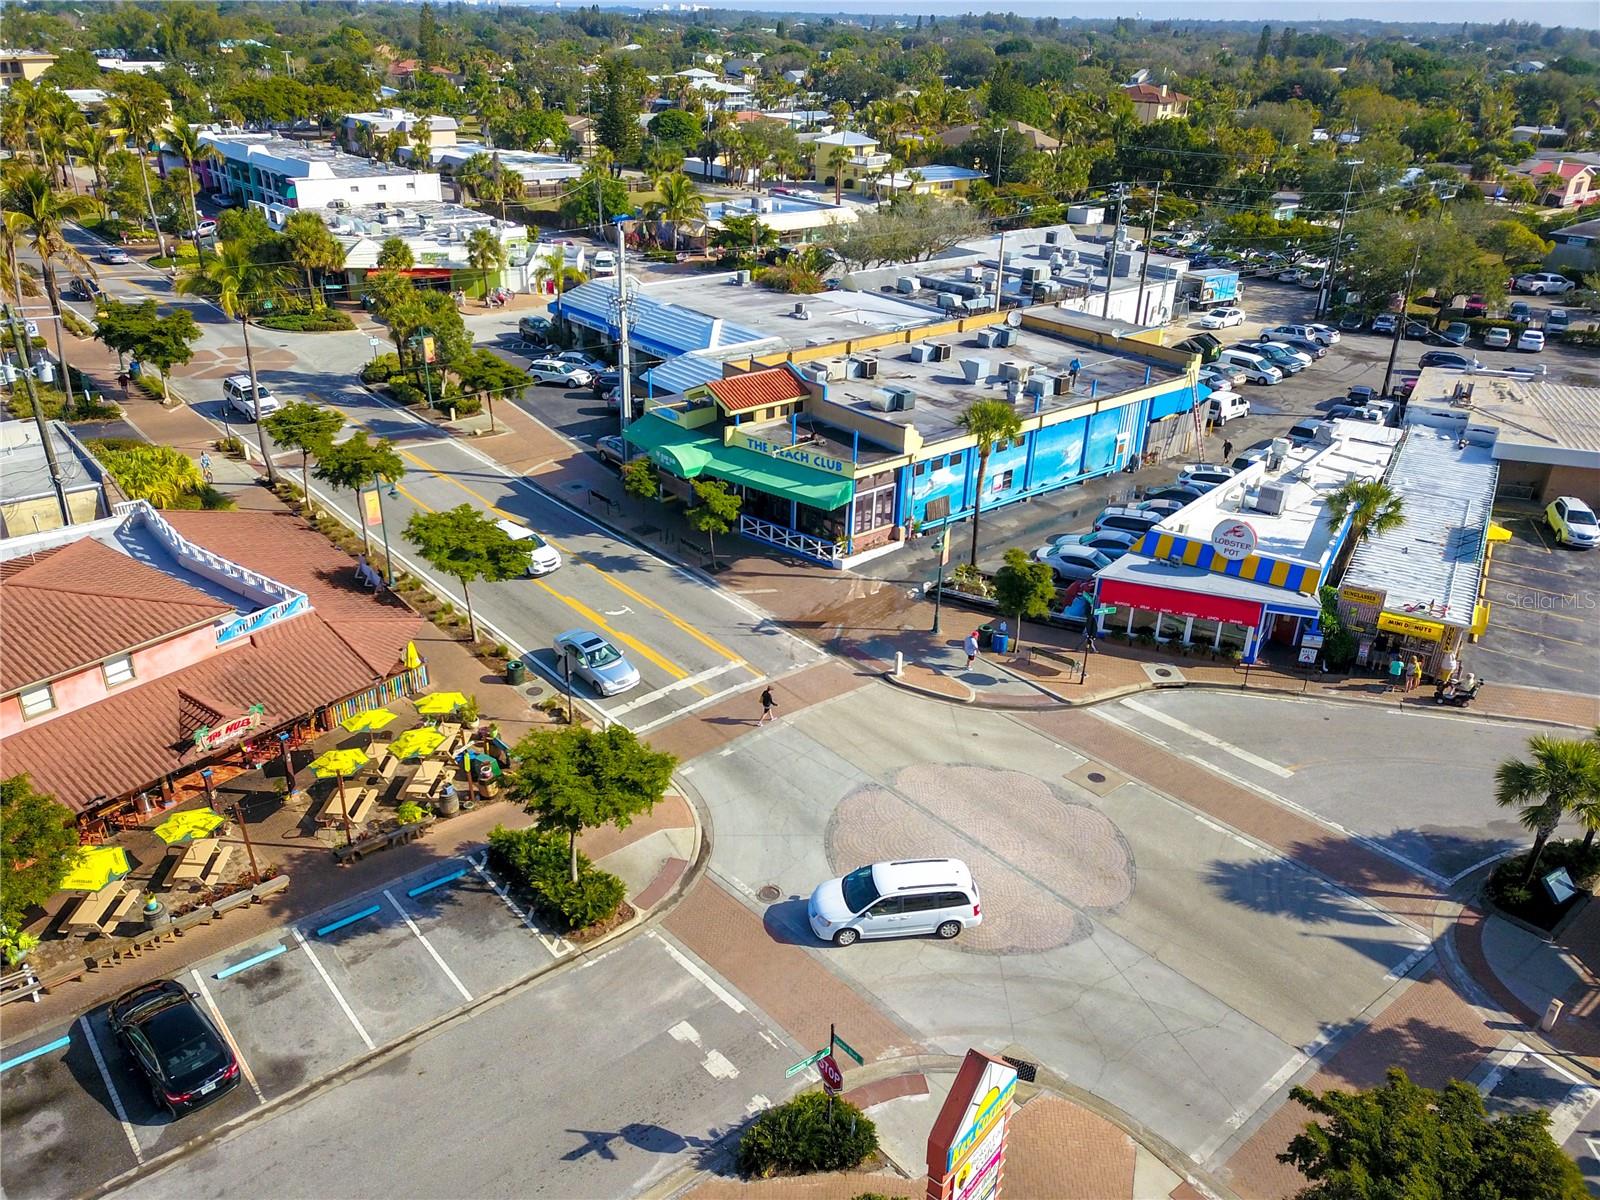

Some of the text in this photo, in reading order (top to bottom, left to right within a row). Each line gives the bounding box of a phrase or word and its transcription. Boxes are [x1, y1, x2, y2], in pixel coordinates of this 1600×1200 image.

[747, 438, 843, 472] THE BEACH CLUB
[1214, 536, 1252, 551] LOBSTER
[1223, 547, 1241, 557] POT
[1343, 590, 1376, 602] SUNGLASSES
[1387, 619, 1403, 628] MINI
[225, 718, 251, 734] HUB
[819, 1059, 841, 1083] STOP
